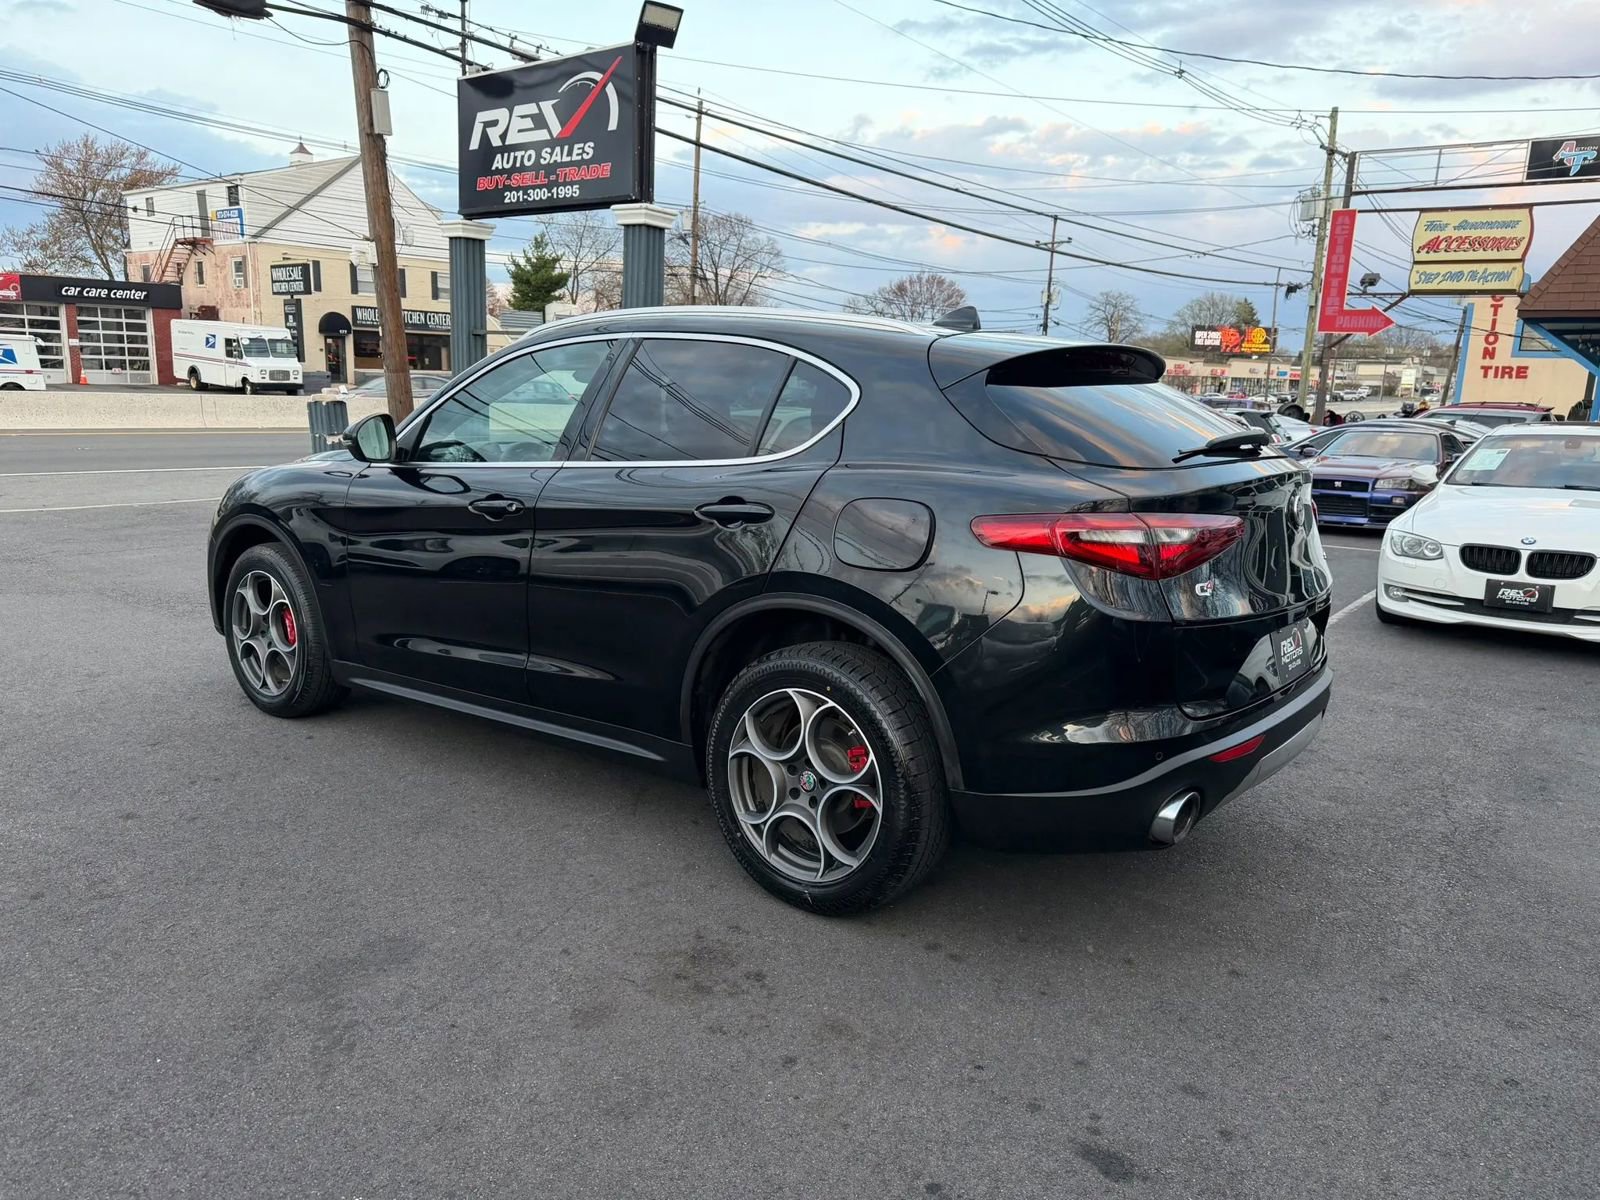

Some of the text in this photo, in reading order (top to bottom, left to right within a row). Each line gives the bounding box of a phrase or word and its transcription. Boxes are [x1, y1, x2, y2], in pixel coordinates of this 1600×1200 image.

[491, 141, 595, 171] AUTO SALES
[503, 185, 580, 204] 201-300-1995
[1330, 215, 1350, 274] ACTION
[1416, 235, 1525, 254] ACCESSORIES
[271, 266, 304, 281] WHOLESALE
[61, 285, 147, 300] car care center
[356, 307, 380, 321] WHOLE
[426, 312, 451, 326] CENTER
[1335, 315, 1385, 329] PARKING
[1480, 365, 1529, 379] TIRE
[1496, 595, 1537, 603] MOTORS
[1281, 646, 1304, 665] MOTORS
